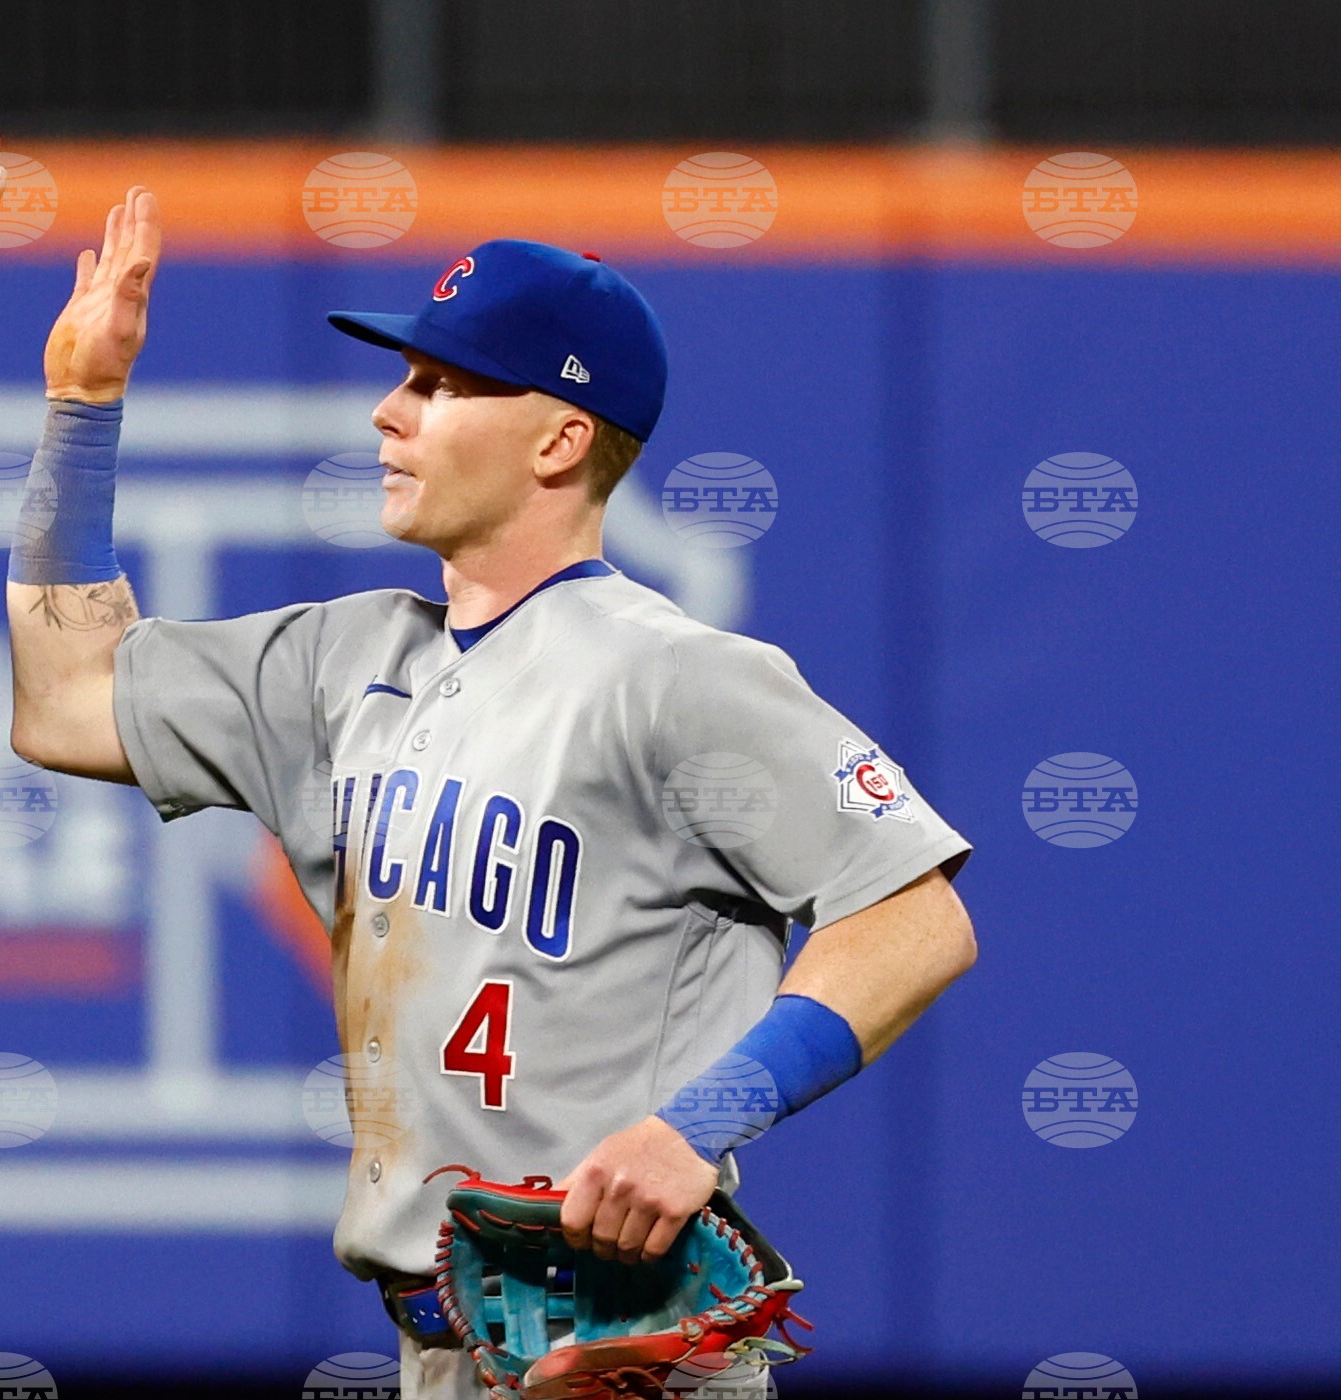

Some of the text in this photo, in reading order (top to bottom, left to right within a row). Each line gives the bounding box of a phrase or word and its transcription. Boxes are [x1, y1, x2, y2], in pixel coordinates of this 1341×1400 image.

[432, 256, 475, 301] C
[332, 765, 584, 962] HICAGO
[440, 979, 516, 1111] 4
